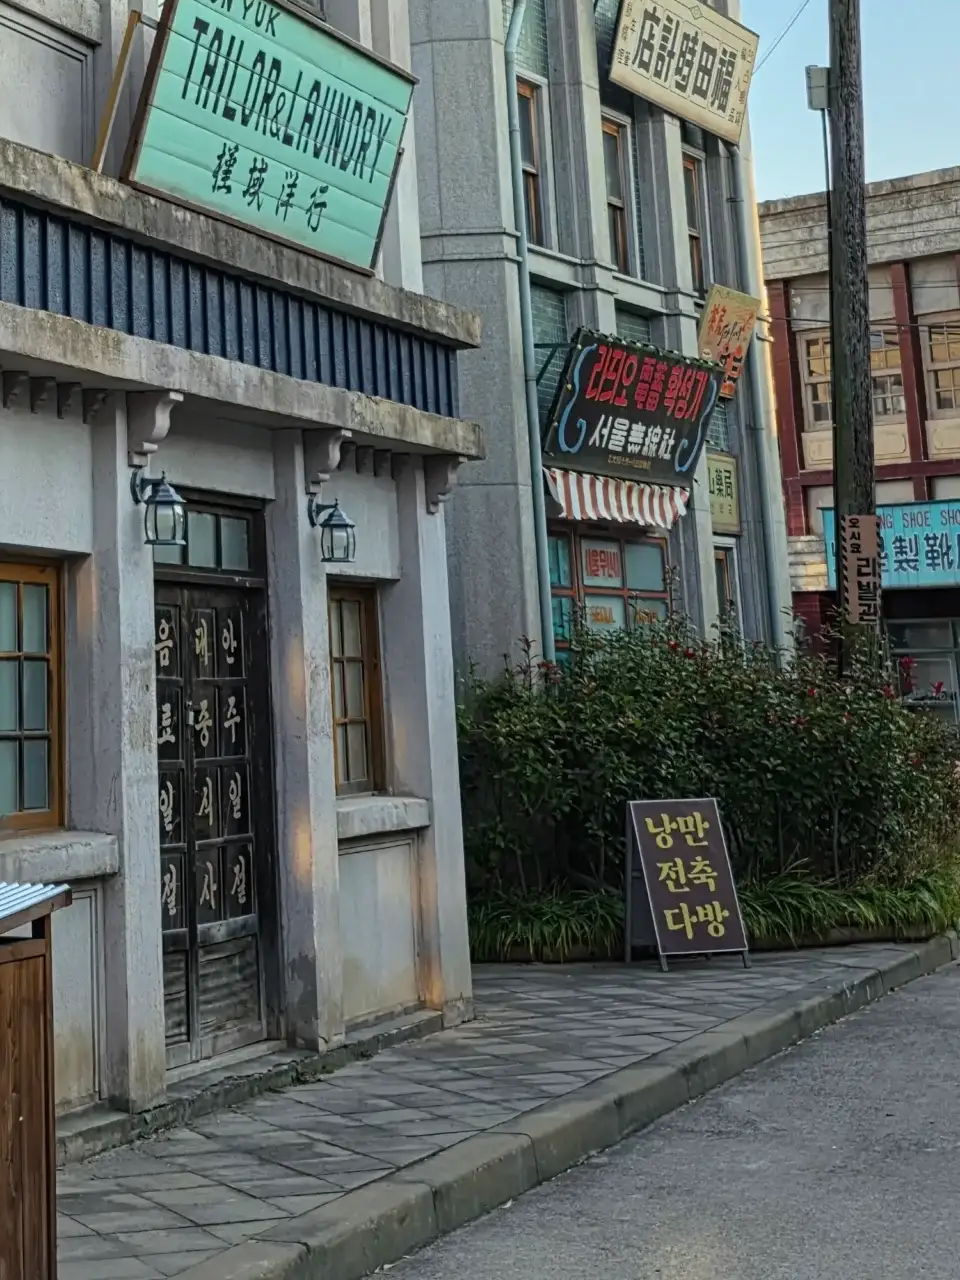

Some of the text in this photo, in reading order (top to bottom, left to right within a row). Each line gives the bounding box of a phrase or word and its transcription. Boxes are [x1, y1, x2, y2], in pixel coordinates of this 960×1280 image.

[663, 365, 709, 422] 확성기
[879, 512, 893, 529] NG
[902, 510, 931, 529] SHOE
[644, 811, 710, 849] 낭만
[656, 855, 718, 893] 전축
[663, 900, 730, 940] 다방
